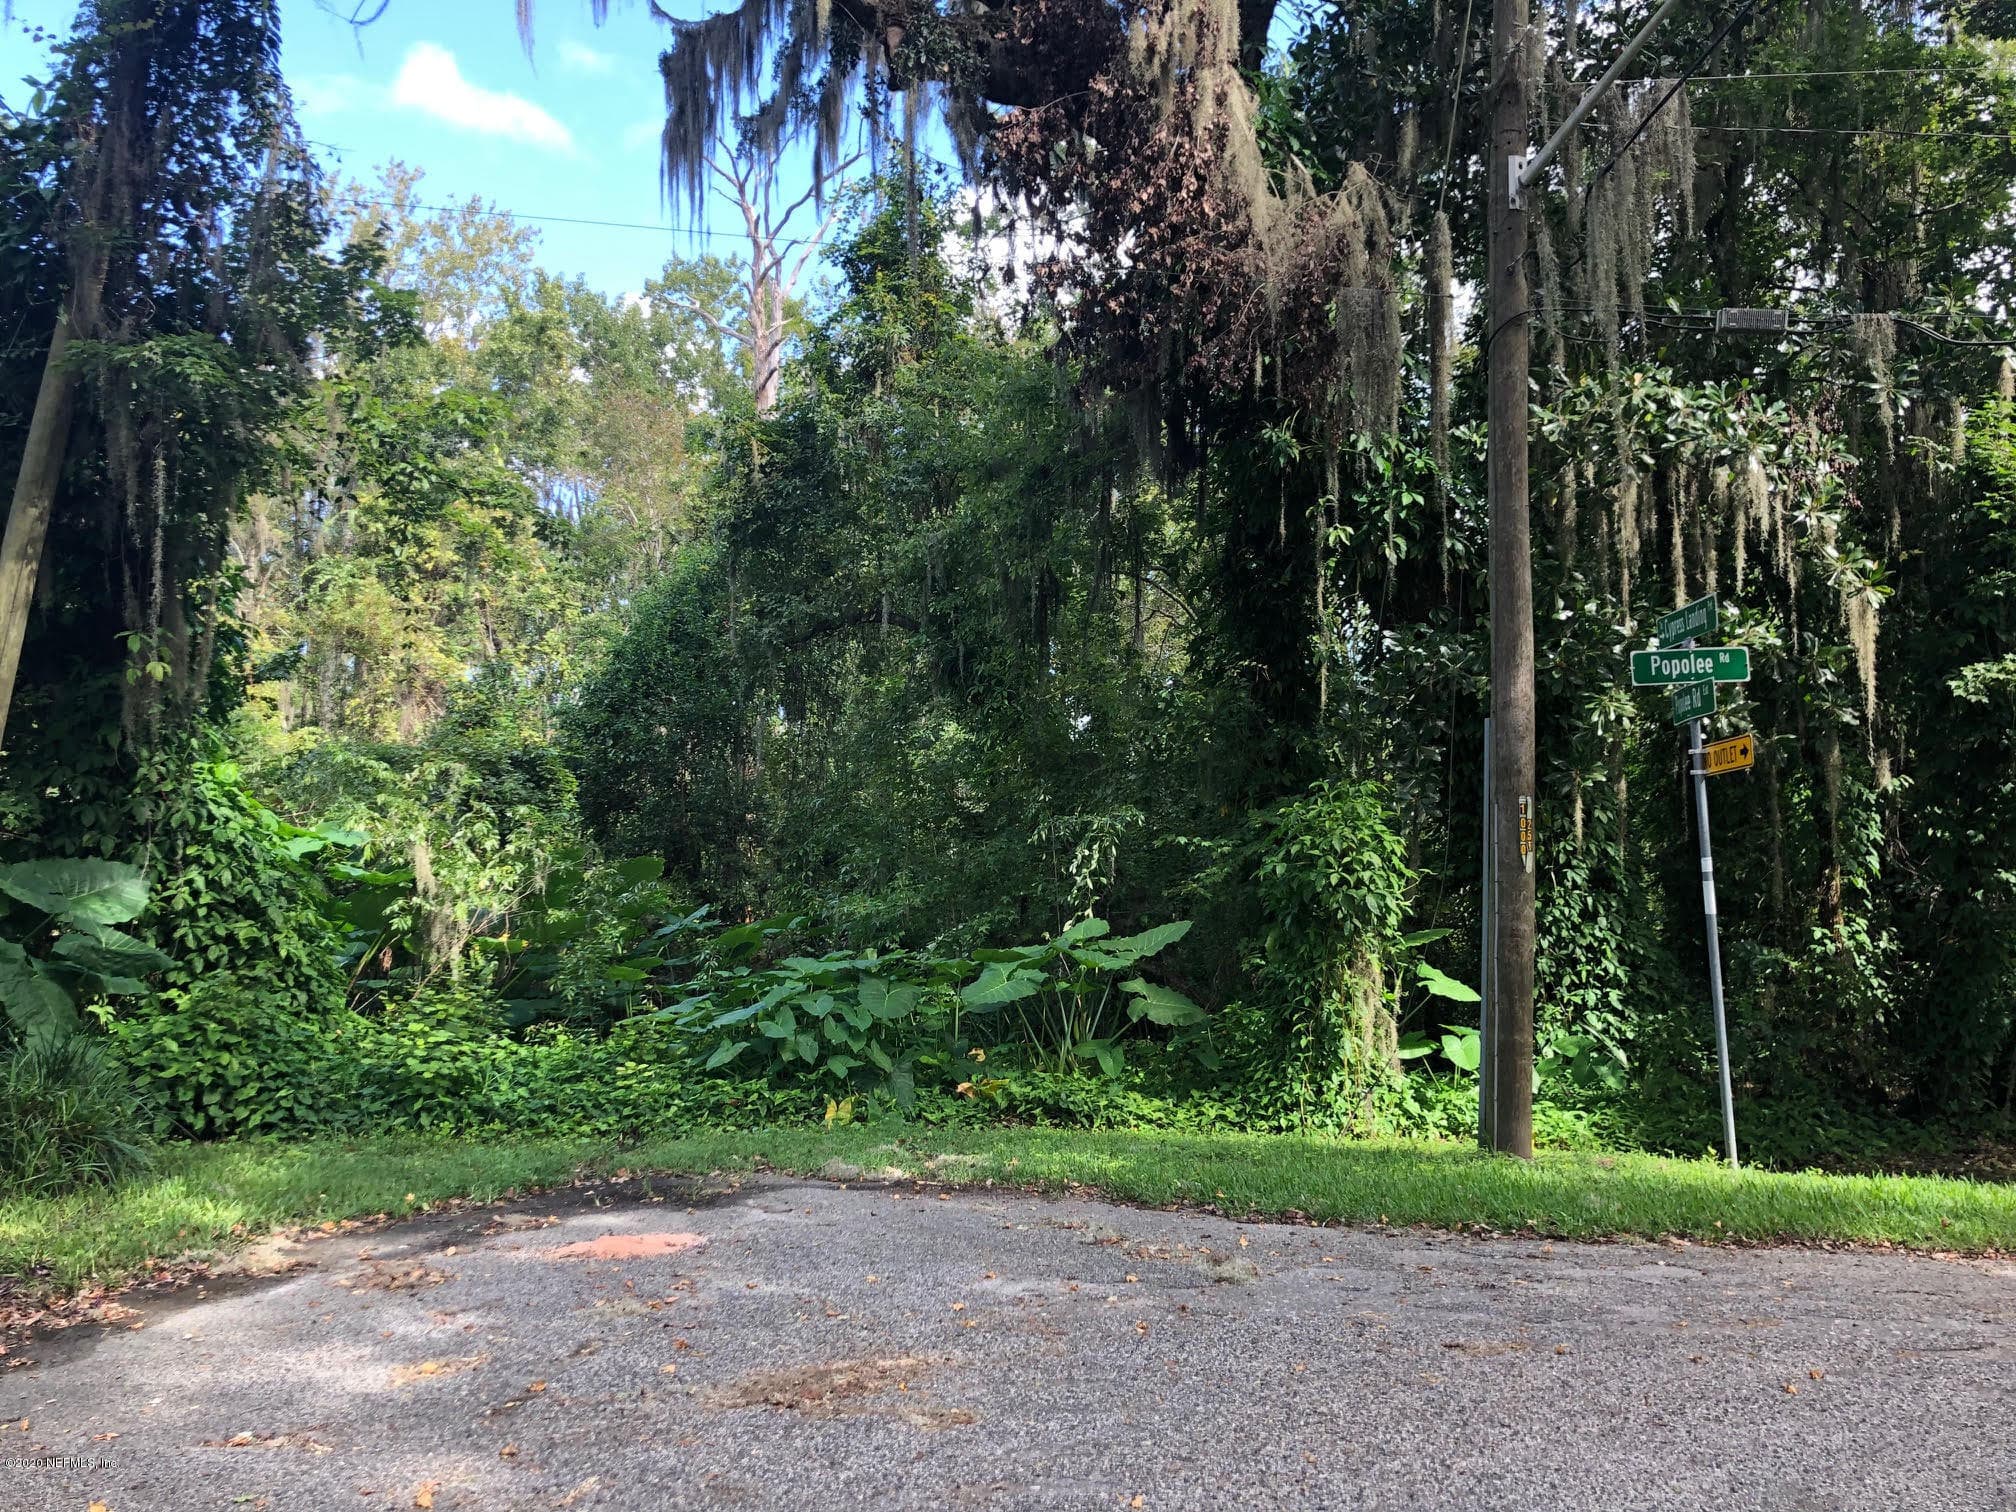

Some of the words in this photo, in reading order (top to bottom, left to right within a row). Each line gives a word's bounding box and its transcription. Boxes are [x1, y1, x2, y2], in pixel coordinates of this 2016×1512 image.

[1664, 617, 1685, 642] Cypress
[1685, 604, 1707, 630] Landing
[1650, 654, 1714, 679] Popolee
[1719, 652, 1730, 664] Rd
[1714, 745, 1737, 767] OUTLET
